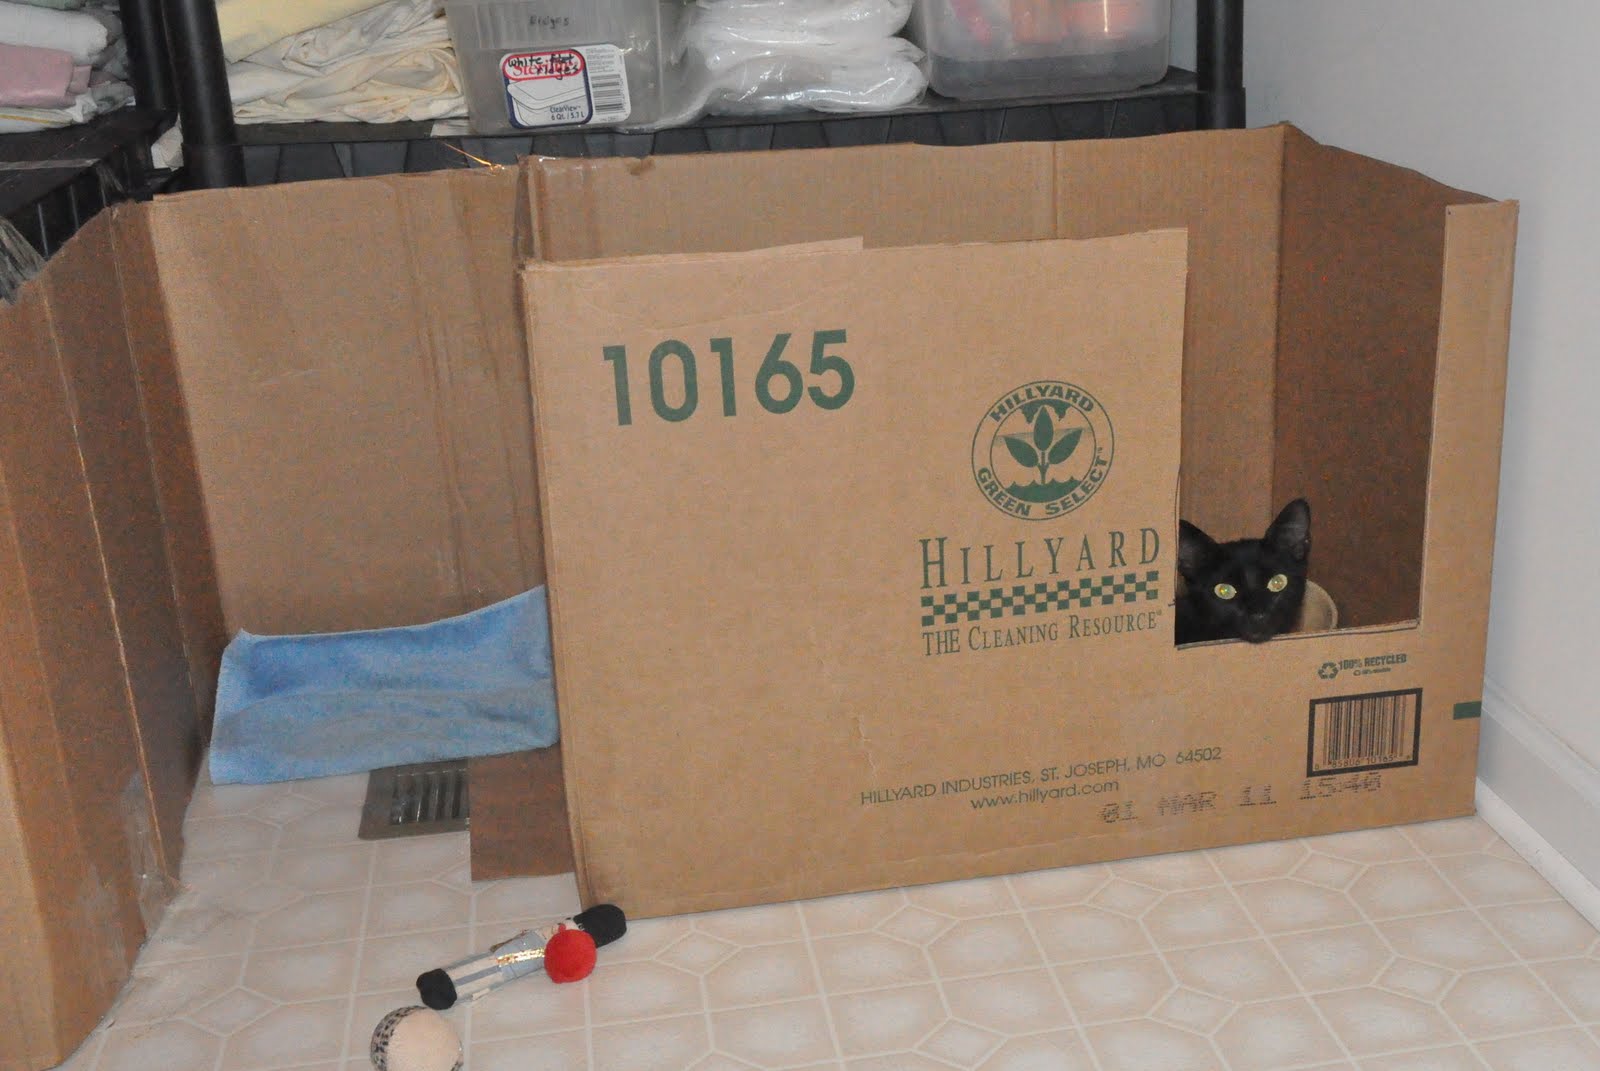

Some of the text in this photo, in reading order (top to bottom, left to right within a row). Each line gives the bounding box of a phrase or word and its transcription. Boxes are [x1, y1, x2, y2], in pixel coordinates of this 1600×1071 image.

[602, 328, 856, 426] 10165
[989, 384, 1095, 423] HILLYARD
[976, 466, 1032, 517] GREEN
[918, 527, 1161, 590] HILLYARD
[921, 628, 961, 657] THE
[967, 625, 1059, 652] CLEANING
[1364, 653, 1407, 668] RECYCLED
[859, 746, 1223, 806] HILLYARD INDUSTRIES, ST. JOSEPH, MO 64502
[970, 778, 1120, 810] www.hillyard.com
